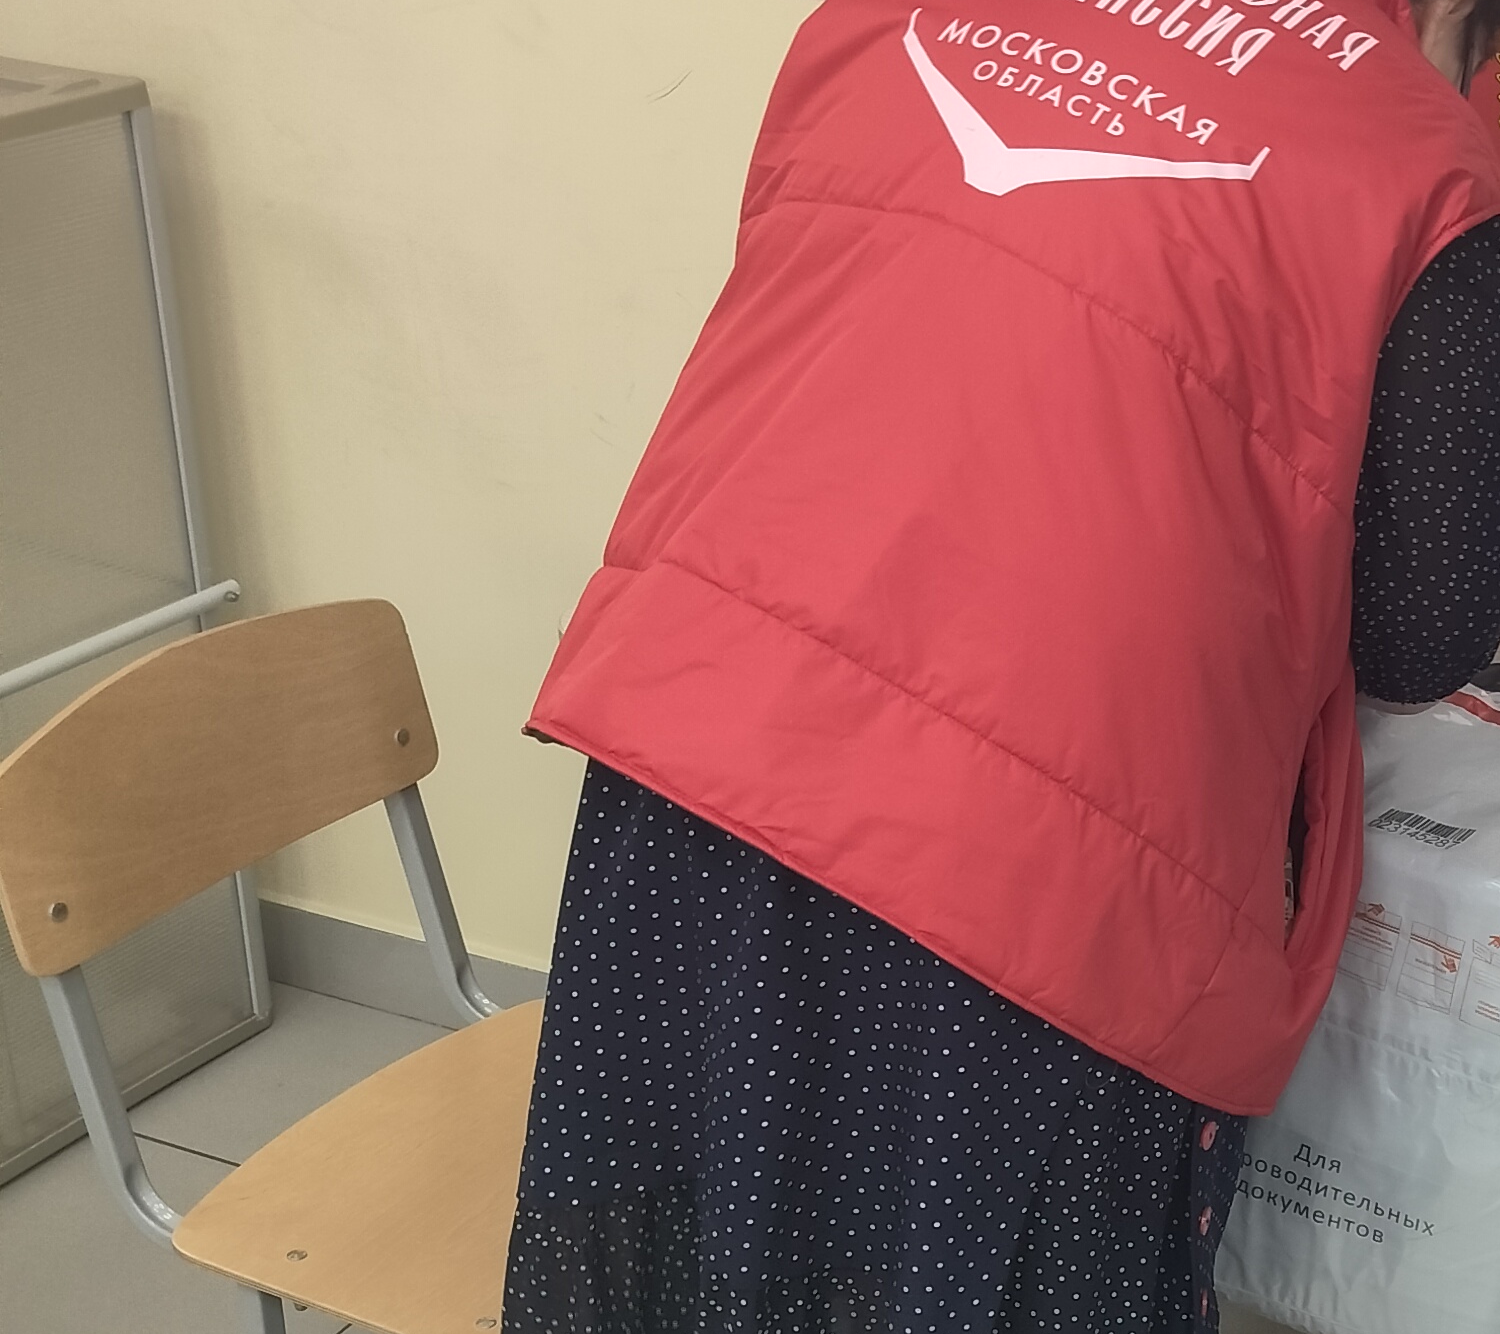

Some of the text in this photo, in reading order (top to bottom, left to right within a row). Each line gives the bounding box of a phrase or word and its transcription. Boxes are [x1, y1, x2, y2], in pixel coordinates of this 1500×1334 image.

[936, 18, 1219, 145] МОСКОВСКАЯ
[972, 60, 1126, 136] ОБЛАСТЬ
[1292, 1143, 1342, 1174] Для
[1236, 1179, 1385, 1244] документов
